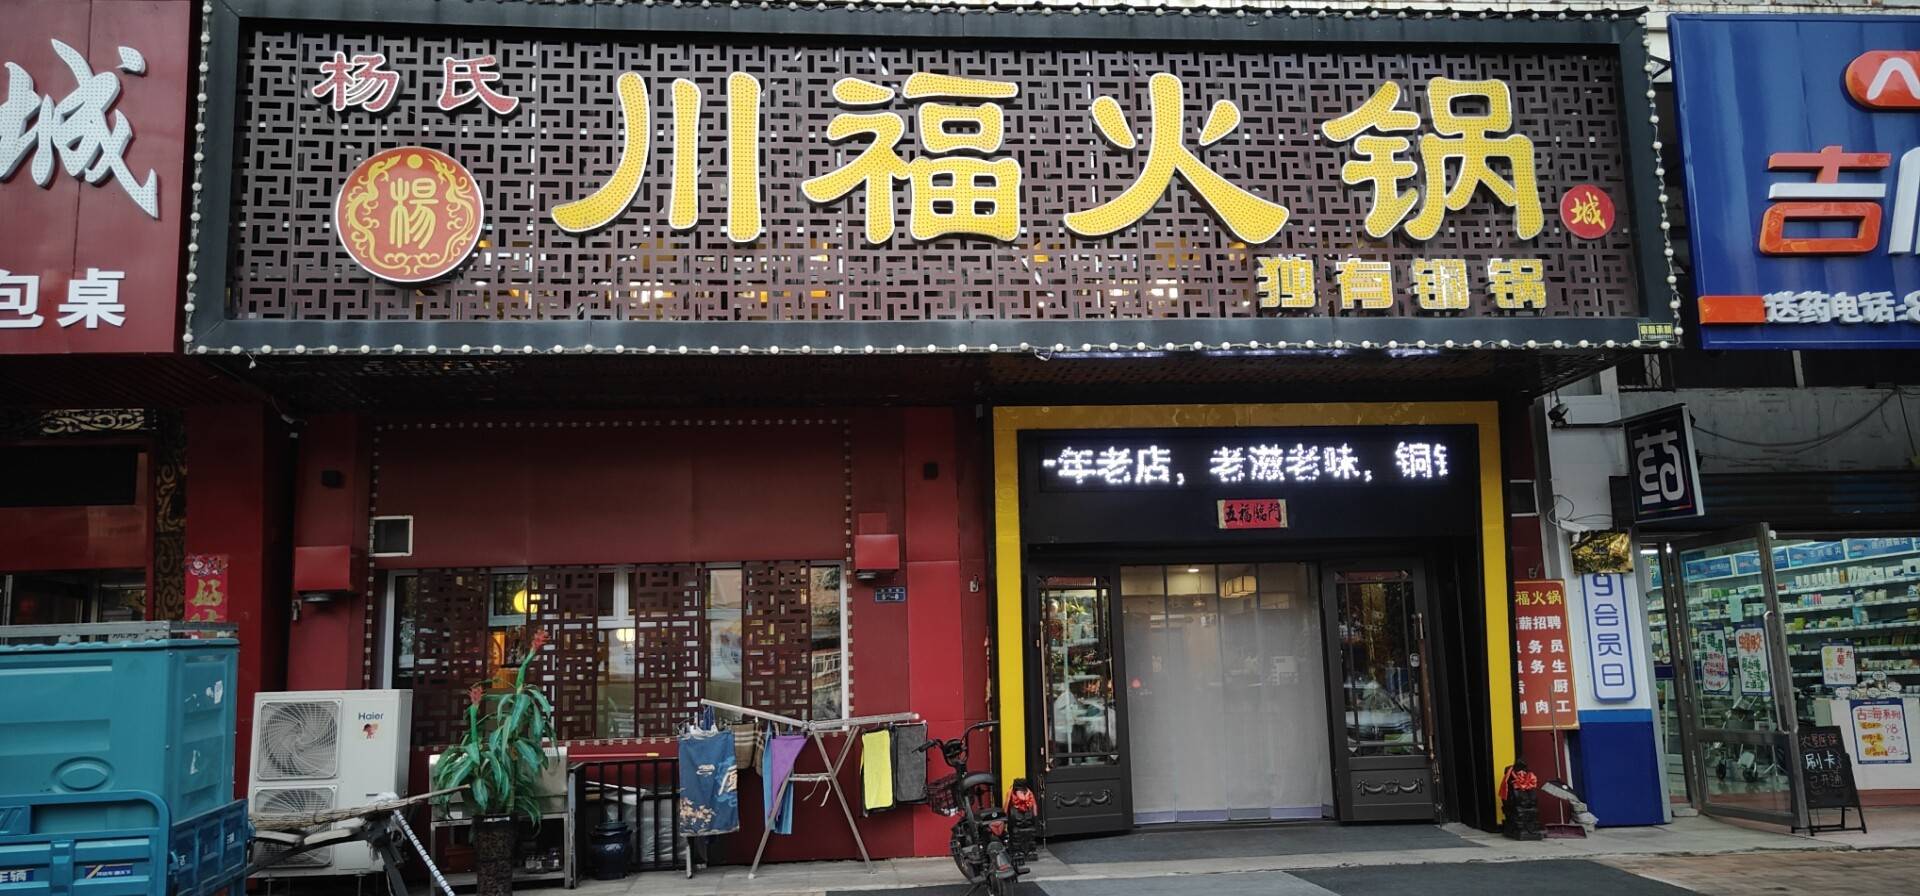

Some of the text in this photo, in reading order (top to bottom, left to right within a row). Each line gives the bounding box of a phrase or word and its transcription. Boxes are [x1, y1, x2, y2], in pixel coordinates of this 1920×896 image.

[312, 52, 519, 114] 杨氏
[551, 72, 1544, 244] 川福火锅
[389, 177, 439, 249] 楊
[1570, 198, 1607, 229] 城
[1759, 145, 1920, 255] 吉
[0, 268, 126, 329] 包桌
[1635, 429, 1684, 505] 药
[1516, 615, 1561, 630] 薪招聘
[358, 711, 383, 720] Haier
[1805, 750, 1835, 769] 刷卡
